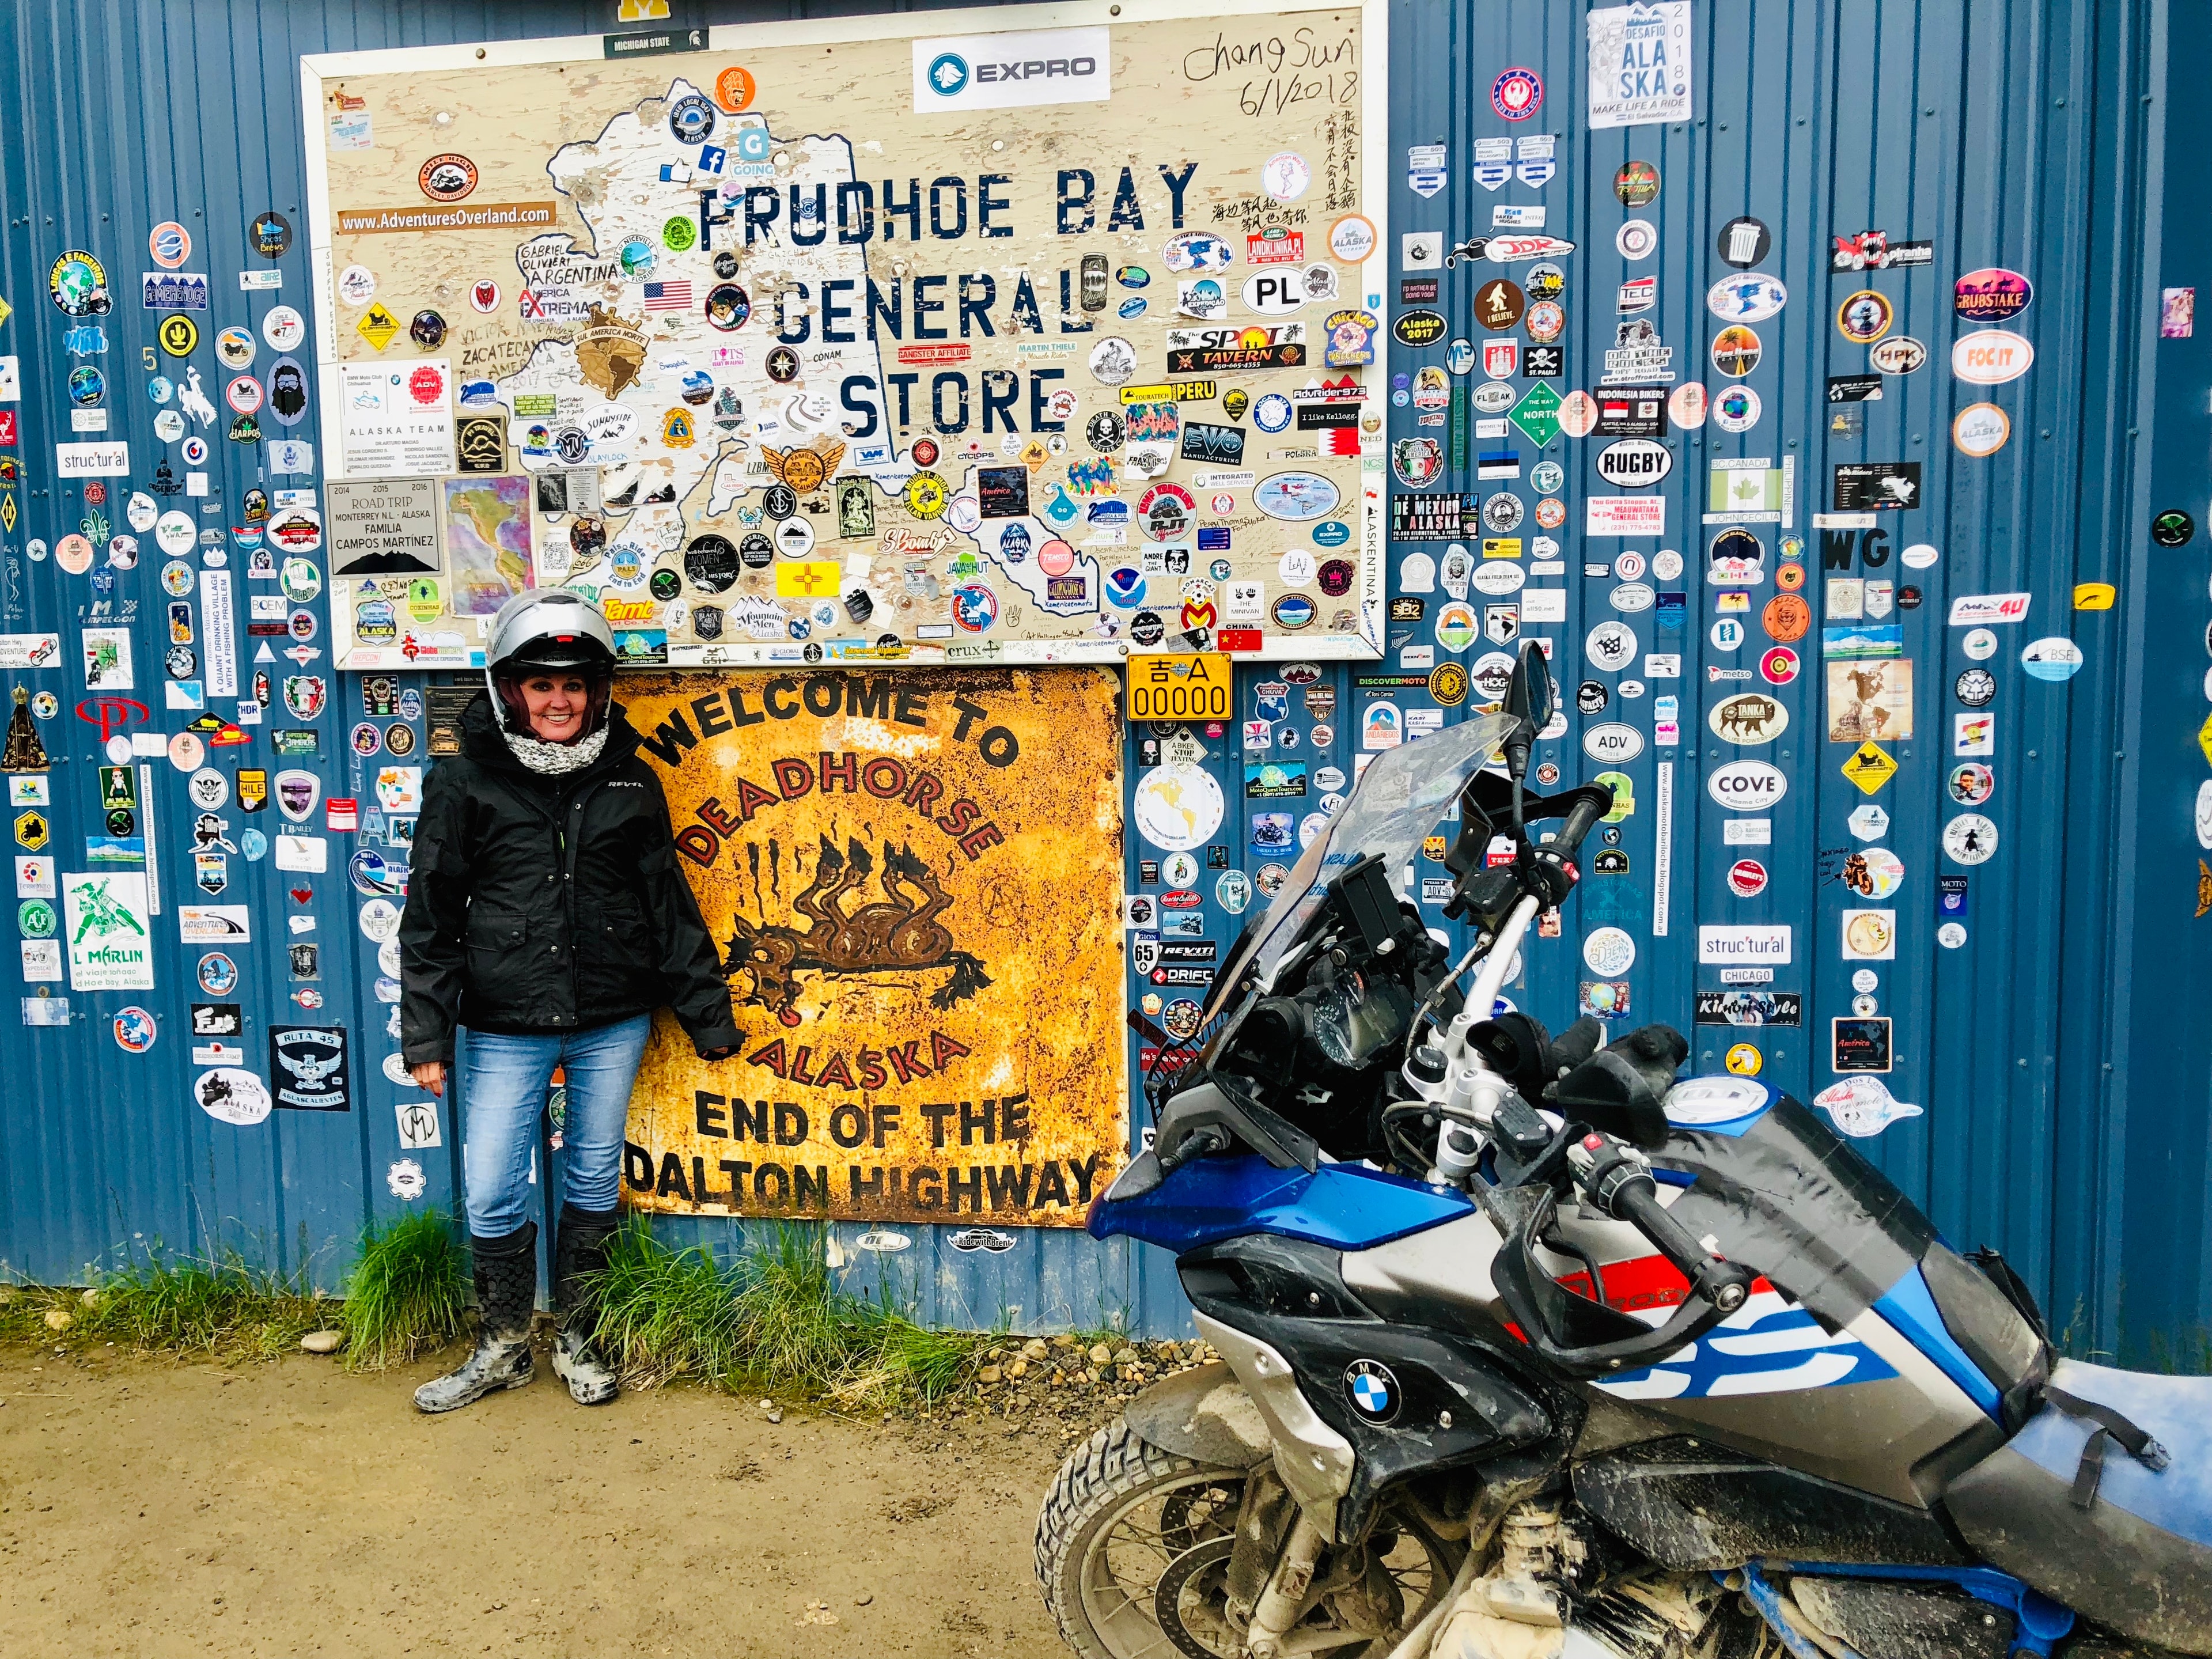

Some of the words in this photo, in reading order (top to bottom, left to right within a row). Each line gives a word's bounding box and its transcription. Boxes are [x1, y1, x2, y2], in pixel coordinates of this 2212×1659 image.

[1626, 24, 1665, 40] DESAFIO
[614, 38, 649, 51] MICHIGAN
[650, 36, 669, 48] STATE
[1184, 32, 1285, 81] Chang
[1290, 28, 1354, 68] Sun
[1622, 40, 1666, 69] ALA
[977, 56, 1096, 83] EXPRO
[1620, 69, 1667, 99] SKA
[1240, 71, 1357, 116] 6/1/2018
[1593, 103, 1622, 115] MAKE
[1626, 101, 1648, 111] LIFE
[1650, 100, 1657, 108] A
[1660, 98, 1684, 108] RIDE
[744, 135, 762, 154] G
[1057, 162, 1199, 235] BAY
[343, 207, 550, 229] www.AdventuresOverland.com
[700, 175, 1013, 251] PRUDHOE
[260, 234, 282, 244] Shoes
[1248, 237, 1303, 255] LANDKLINIKA.PL
[1332, 236, 1372, 248] ALASKA
[260, 244, 283, 252] Brews
[521, 245, 565, 258] GABRIEL
[51, 258, 66, 291] LOUCOS
[73, 251, 105, 286] FACEIROS
[523, 257, 570, 270] OLIVIERI
[531, 264, 618, 285] ARGENTINA
[1256, 278, 1301, 305] PL
[774, 270, 1094, 344] GENERAL
[1956, 293, 2022, 308] GRUBSTAKE
[1401, 318, 1440, 329] Alaska
[1493, 312, 1515, 322] BELIEVE.
[1200, 327, 1283, 349] SPOT
[1407, 329, 1433, 339] 2017
[899, 349, 935, 358] GANGSTER
[938, 347, 971, 357] AFFILIATE
[1018, 343, 1048, 351] MARTIN
[813, 350, 842, 362] CONAM
[1202, 349, 1272, 364] TAVERN
[1880, 349, 1916, 362] HPK
[1967, 349, 1995, 367] FOC
[1998, 348, 2013, 366] IT
[416, 381, 436, 389] ADV
[1603, 373, 1673, 382] www.otroffroad.com
[1176, 381, 1215, 399] PERU
[1598, 391, 1638, 400] INDONESIA
[1641, 391, 1665, 399] BIKERS
[840, 368, 1066, 438] STORE
[1326, 413, 1357, 422] Kellogg.
[1524, 410, 1558, 419] NORTH
[229, 428, 261, 440] HARPOS
[350, 426, 402, 435] ALASKA
[410, 425, 445, 433] TEAM
[1183, 453, 1239, 463] MANUFACTURING
[1604, 452, 1665, 473] RUGBY
[1712, 460, 1768, 468] BC.CANADA
[1210, 473, 1253, 481] INTEGRATED
[1784, 457, 1793, 515] PHILIPPINES
[352, 498, 384, 509] ROAD
[387, 496, 412, 508] TRIP
[1414, 499, 1459, 513] MEXICO
[335, 512, 379, 521] MONTERREY
[402, 510, 430, 518] ALASKA
[1409, 515, 1460, 529] ALASKA
[1712, 513, 1780, 522] JOHN/CECILIA
[365, 524, 402, 535] FAMILIA
[336, 539, 379, 550] CAMPOS
[383, 535, 434, 547] MARTÍNEZ
[1825, 529, 1855, 570] W
[1862, 529, 1889, 566] G
[690, 552, 719, 565] WOMEN
[1043, 552, 1070, 563] TEMSCO
[1144, 552, 1163, 560] ANDRE
[946, 560, 967, 574] JAVA
[974, 560, 988, 574] HUT
[211, 573, 219, 609] VILLAGE
[221, 578, 229, 619] PROBLEM
[253, 599, 286, 611] BOEM
[1999, 598, 2024, 613] 4U
[737, 612, 784, 628] Mountain
[756, 620, 775, 628] Men
[213, 611, 222, 649] DRINKING
[223, 623, 231, 656] FISHING
[948, 645, 980, 659] crux
[216, 650, 224, 685] QUAINT
[1148, 658, 1172, 682] 吉
[1187, 658, 1210, 682] A
[1359, 677, 1426, 685] DISCOVERMOTO
[1134, 685, 1225, 715] 00000
[240, 704, 258, 714] HDR
[1737, 704, 1766, 716] TANKA
[643, 675, 928, 768] WELCOME
[951, 697, 1020, 768] TO
[1598, 736, 1627, 748] ADV
[1249, 786, 1303, 794] MotoQuestTours.com
[1718, 777, 1775, 792] COVE
[676, 752, 1006, 867] DEADHORSE
[89, 948, 143, 963] MARLIN
[1135, 945, 1153, 962] 65
[1725, 970, 1770, 980] CHICAGO
[283, 1033, 314, 1044] RUTA
[320, 1035, 335, 1043] 45
[747, 1030, 971, 1090] ALASKA
[695, 1090, 808, 1146] END
[830, 1104, 900, 1149] OF
[920, 1090, 1029, 1147] THE
[624, 1140, 828, 1210] DALTON
[850, 1153, 1100, 1213] HIGHWAY
